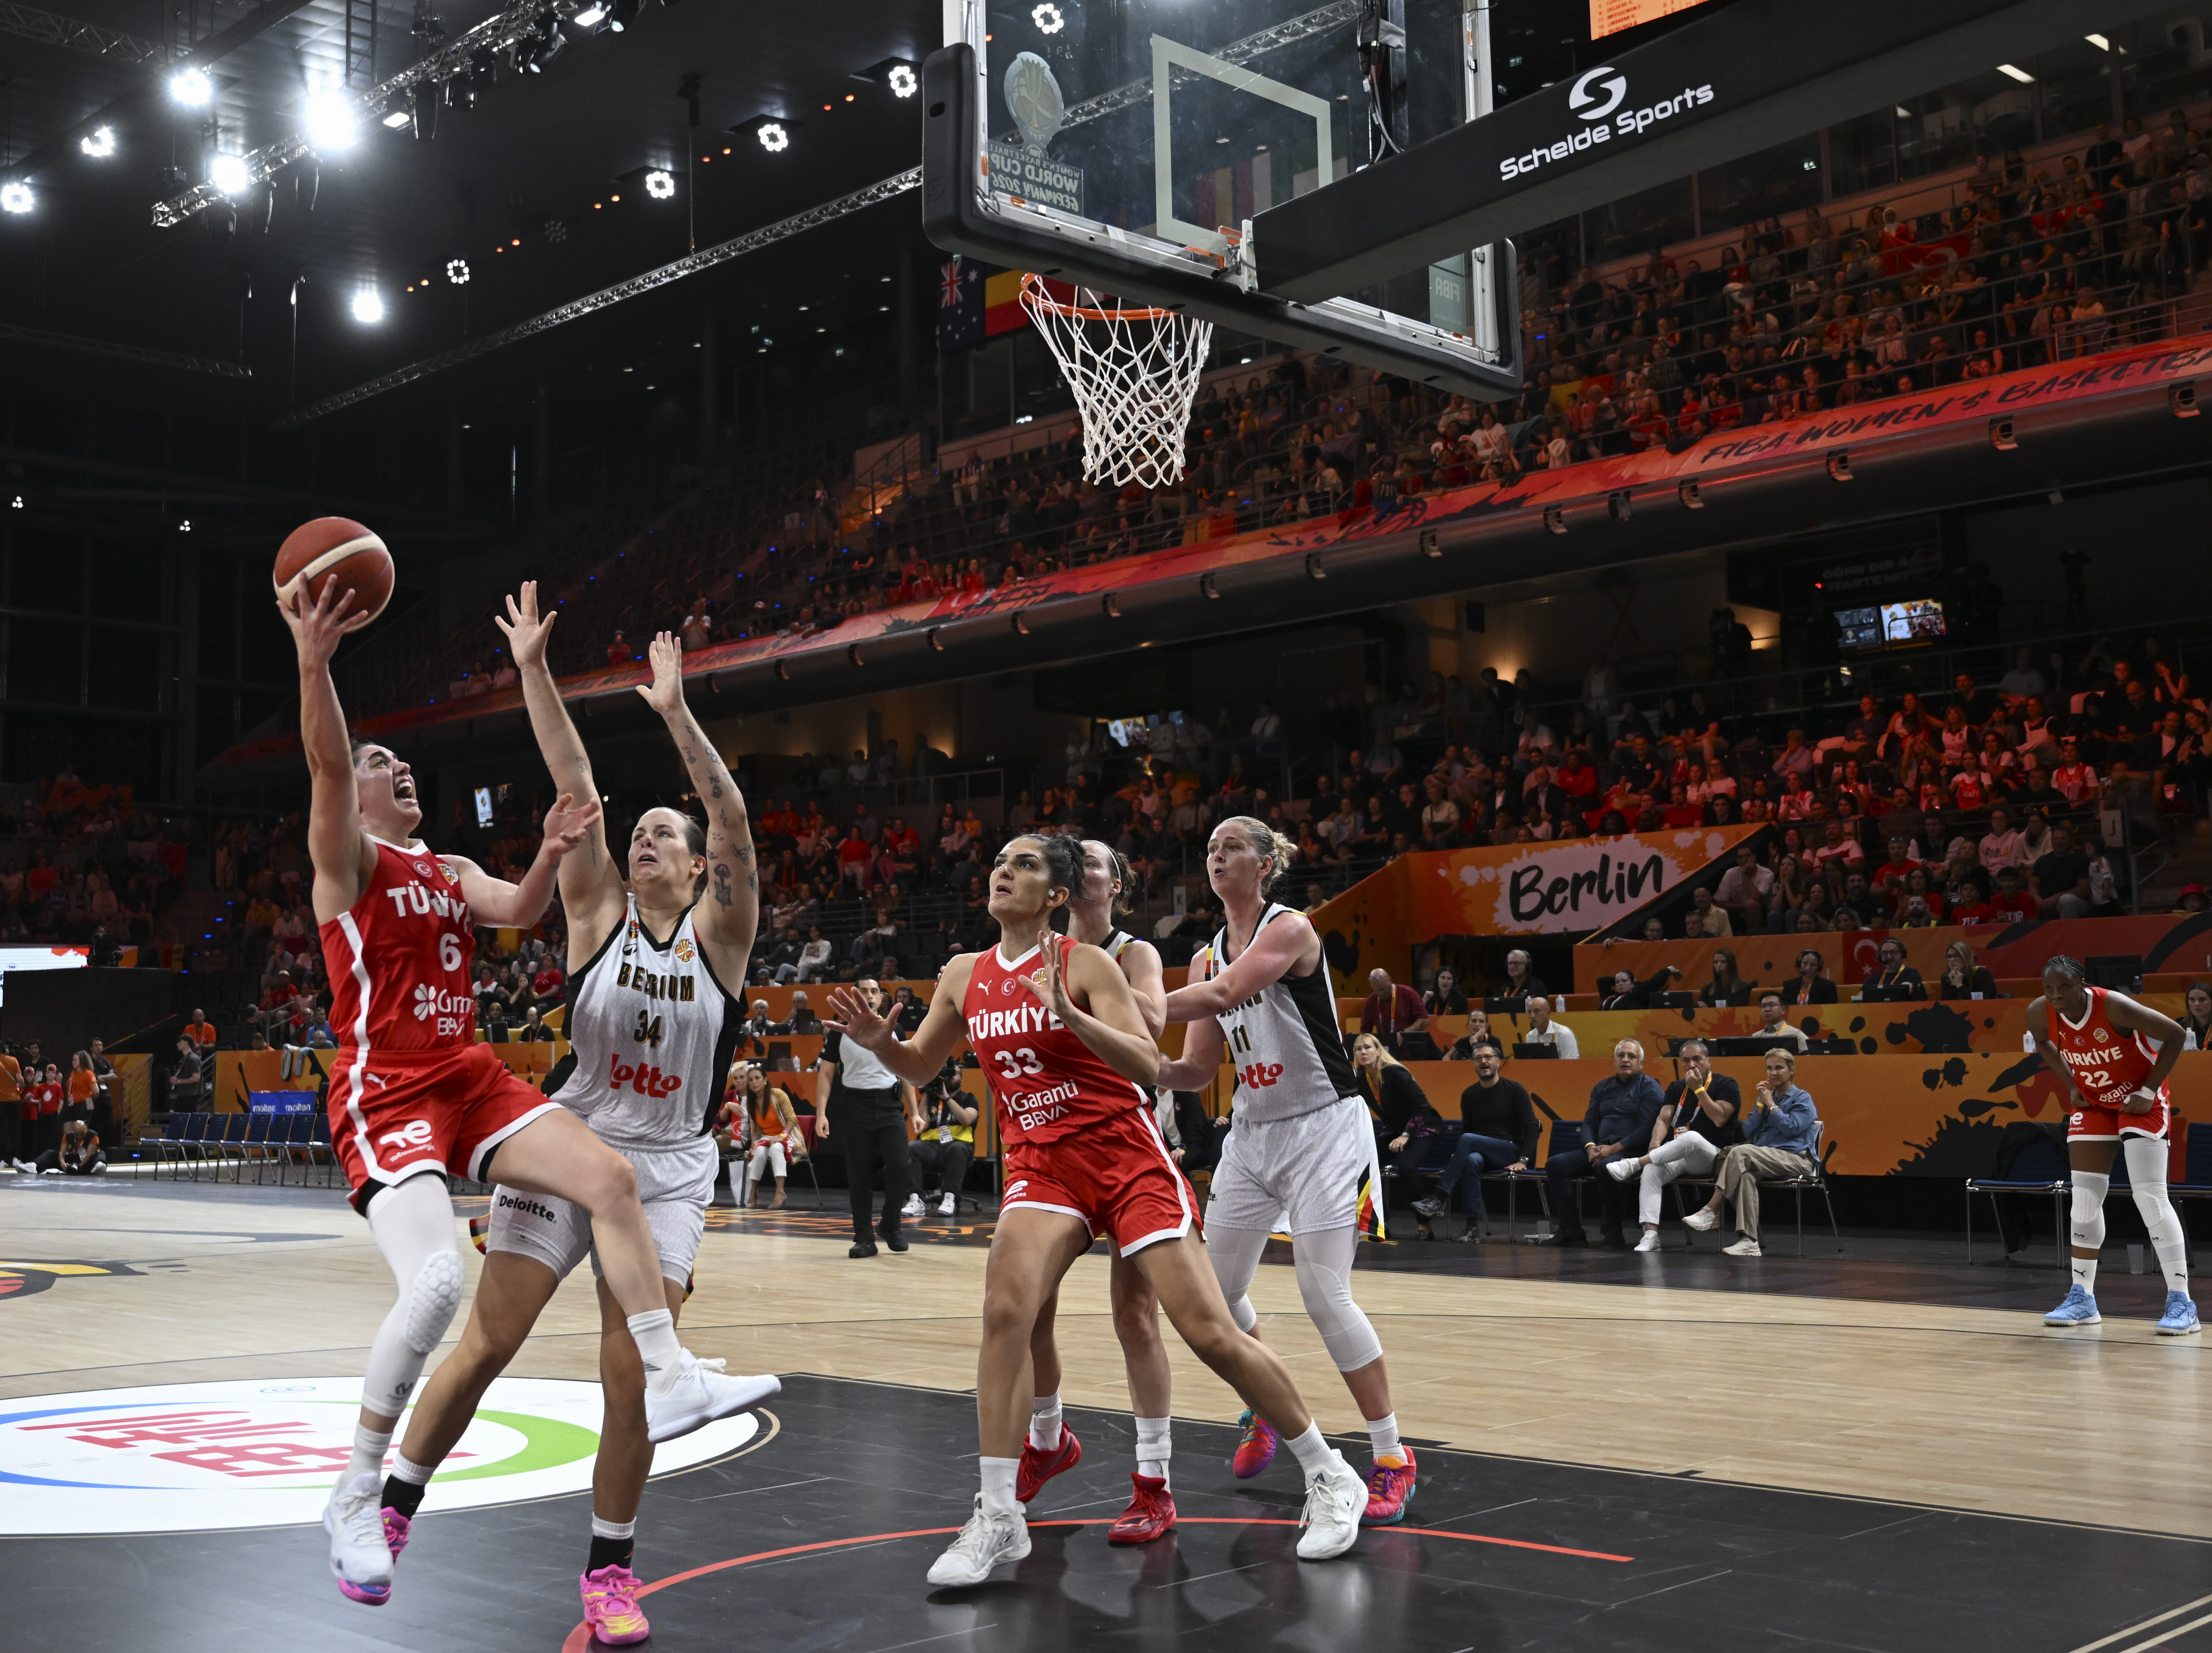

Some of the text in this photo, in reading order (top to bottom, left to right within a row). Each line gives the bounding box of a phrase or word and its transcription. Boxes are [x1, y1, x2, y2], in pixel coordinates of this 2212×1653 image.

[1500, 83, 1715, 181] Schelde Sports
[1701, 434, 1784, 464] FIBA
[1803, 390, 1990, 440] WOMEN'S
[2108, 820, 2116, 836] J
[1176, 894, 1183, 906] K
[1508, 853, 1664, 923] Berlin
[440, 932, 462, 972] 6
[633, 1009, 663, 1048] 34
[1231, 1024, 1252, 1053] 11
[609, 1053, 682, 1099] lotto
[995, 1047, 1045, 1079] 33
[2079, 1071, 2113, 1088] 22
[253, 1104, 276, 1112] molten
[1011, 1079, 1079, 1112] Garanti
